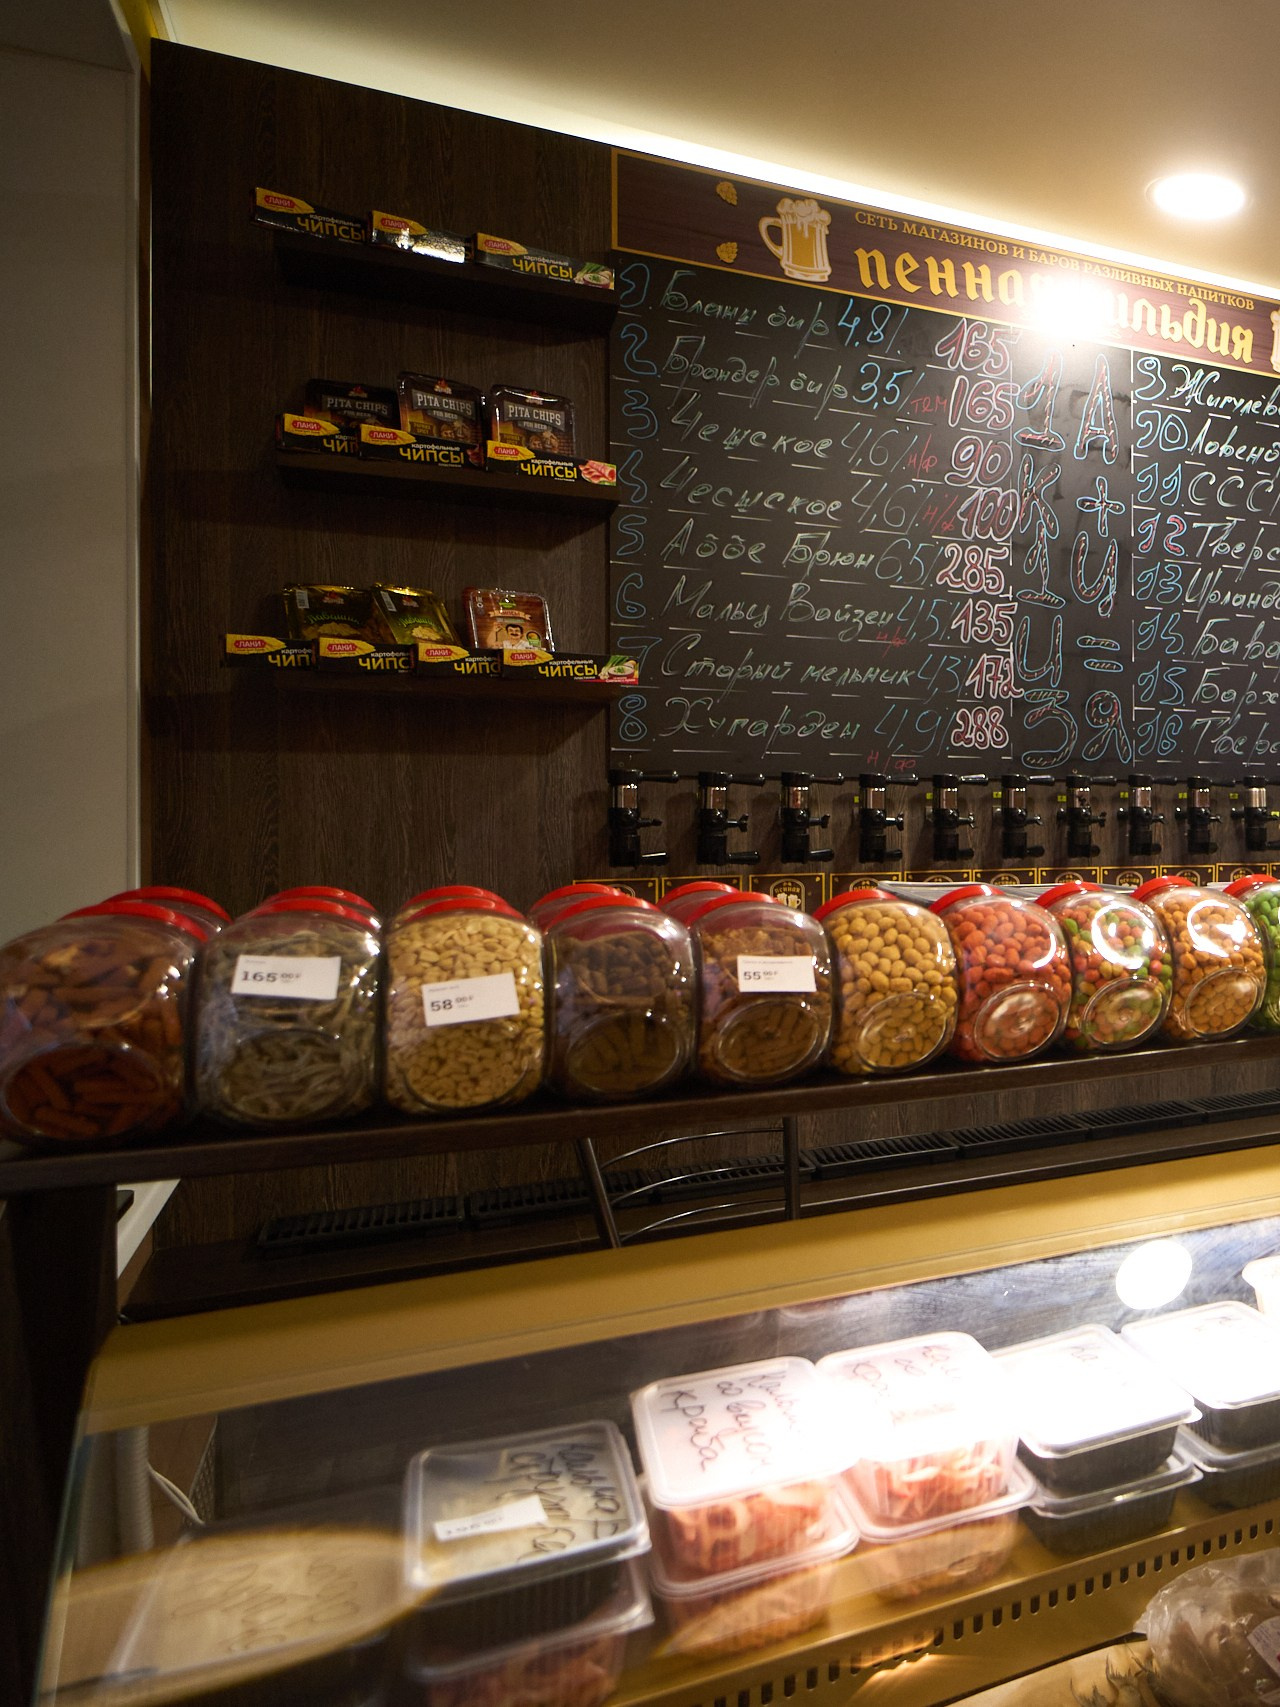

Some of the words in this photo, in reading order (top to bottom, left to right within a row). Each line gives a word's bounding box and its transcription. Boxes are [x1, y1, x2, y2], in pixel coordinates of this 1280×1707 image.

[296, 216, 366, 242] ЧИПСЫ
[512, 258, 573, 280] ЧИПСЫ
[854, 210, 898, 231] СЕТЬ
[902, 221, 1009, 256] МАГАЗИНОВ
[1012, 246, 1025, 260] И
[1028, 250, 1080, 272] БАРОВ
[1083, 261, 1175, 293] РАЗЛИВНЫХ
[1176, 282, 1255, 311] НАПИТКОВ
[1088, 292, 1254, 364] ильдия
[326, 396, 351, 409] PITA
[355, 399, 388, 415] CHIPS
[416, 393, 439, 408] PITA
[443, 397, 473, 416] CHIPS
[948, 375, 1021, 430] 165
[508, 404, 530, 419] PITA
[532, 408, 562, 426] CHIPS
[400, 447, 465, 464] ЧИПСЫ
[520, 462, 578, 479] ЧИПСЫ
[936, 543, 1009, 594] 285
[951, 598, 1018, 646] 135
[538, 664, 598, 678] ЧИПСЫ
[965, 653, 1025, 699] 172
[951, 706, 1009, 749] 288
[242, 970, 278, 983] 165
[430, 998, 453, 1012] 58
